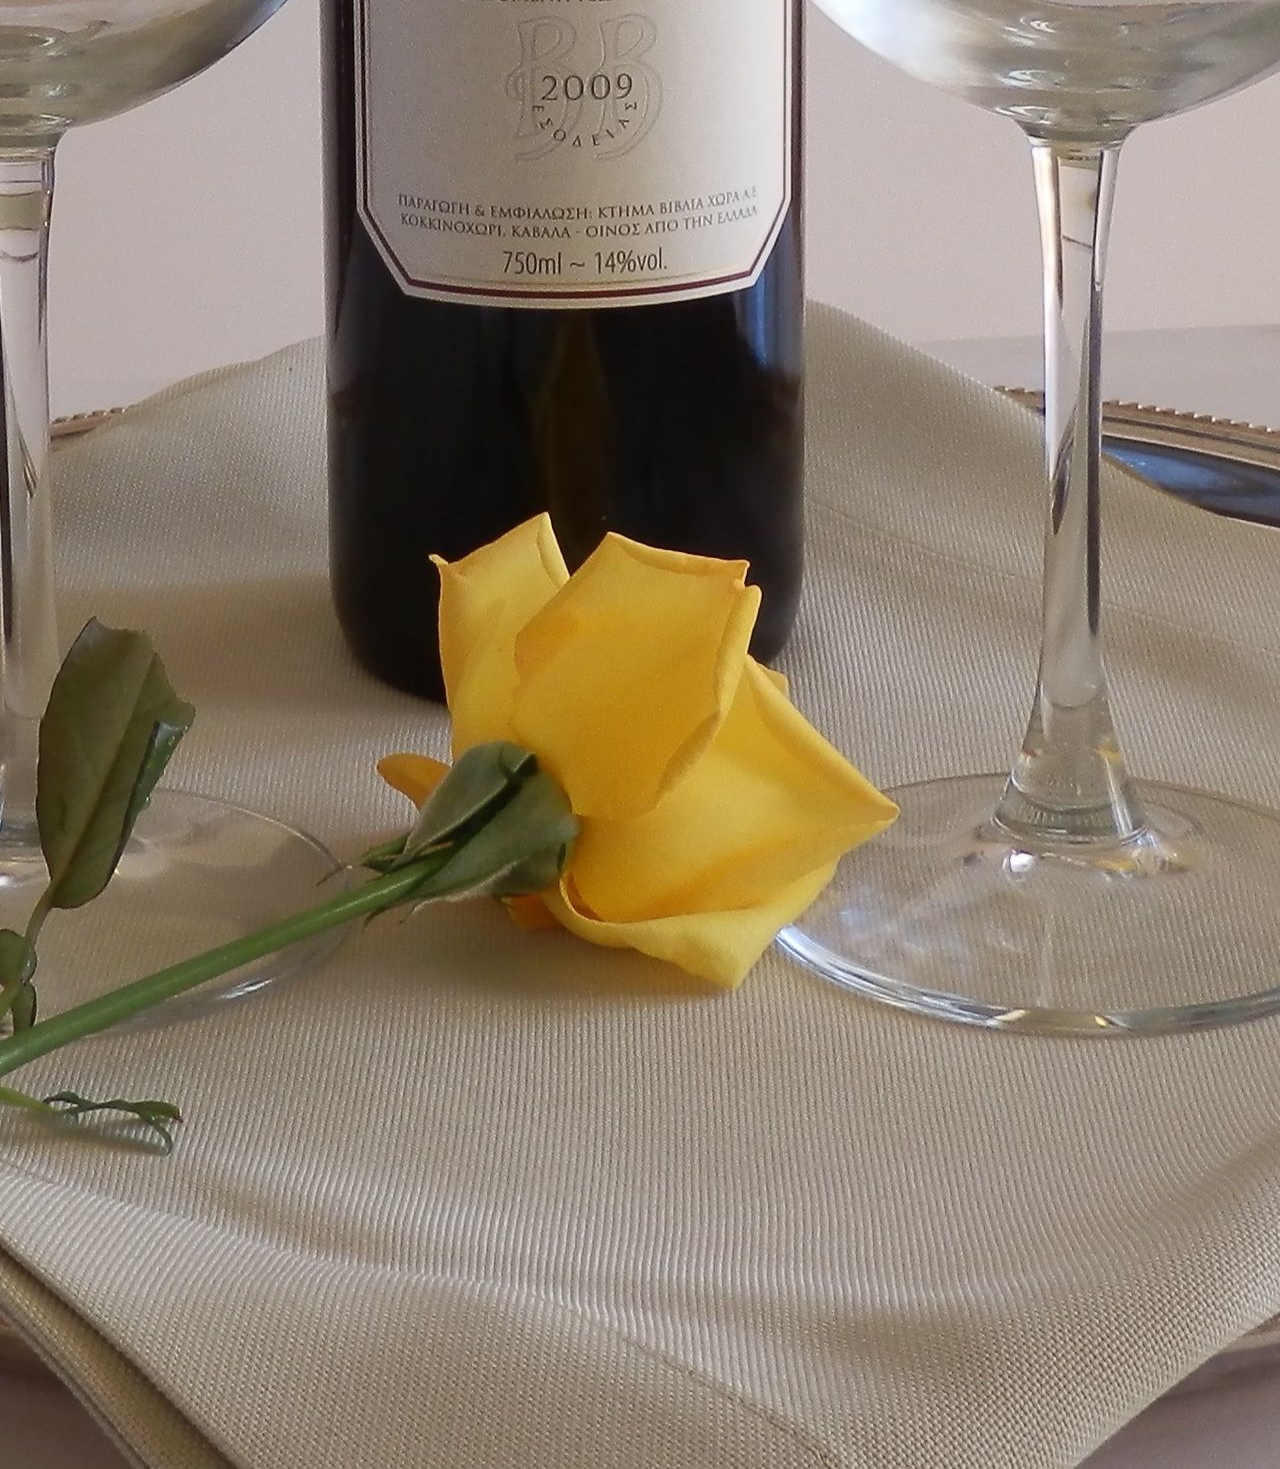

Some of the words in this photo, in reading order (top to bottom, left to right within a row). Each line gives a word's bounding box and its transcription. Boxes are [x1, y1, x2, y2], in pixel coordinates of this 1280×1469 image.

[541, 73, 633, 101] 2009
[474, 205, 485, 217] &
[598, 204, 655, 220] ΚΤΗΜΑ
[708, 191, 740, 208] ΧΩΡΑ
[511, 225, 571, 239] ΚΑΒΑΛΑ
[586, 223, 640, 238] ΟΙΝΟΣ
[644, 221, 679, 235] ΑΠΟ
[682, 213, 713, 231] ΤΗΝ
[503, 250, 562, 275] 750ml
[595, 246, 667, 275] 14%vol.
